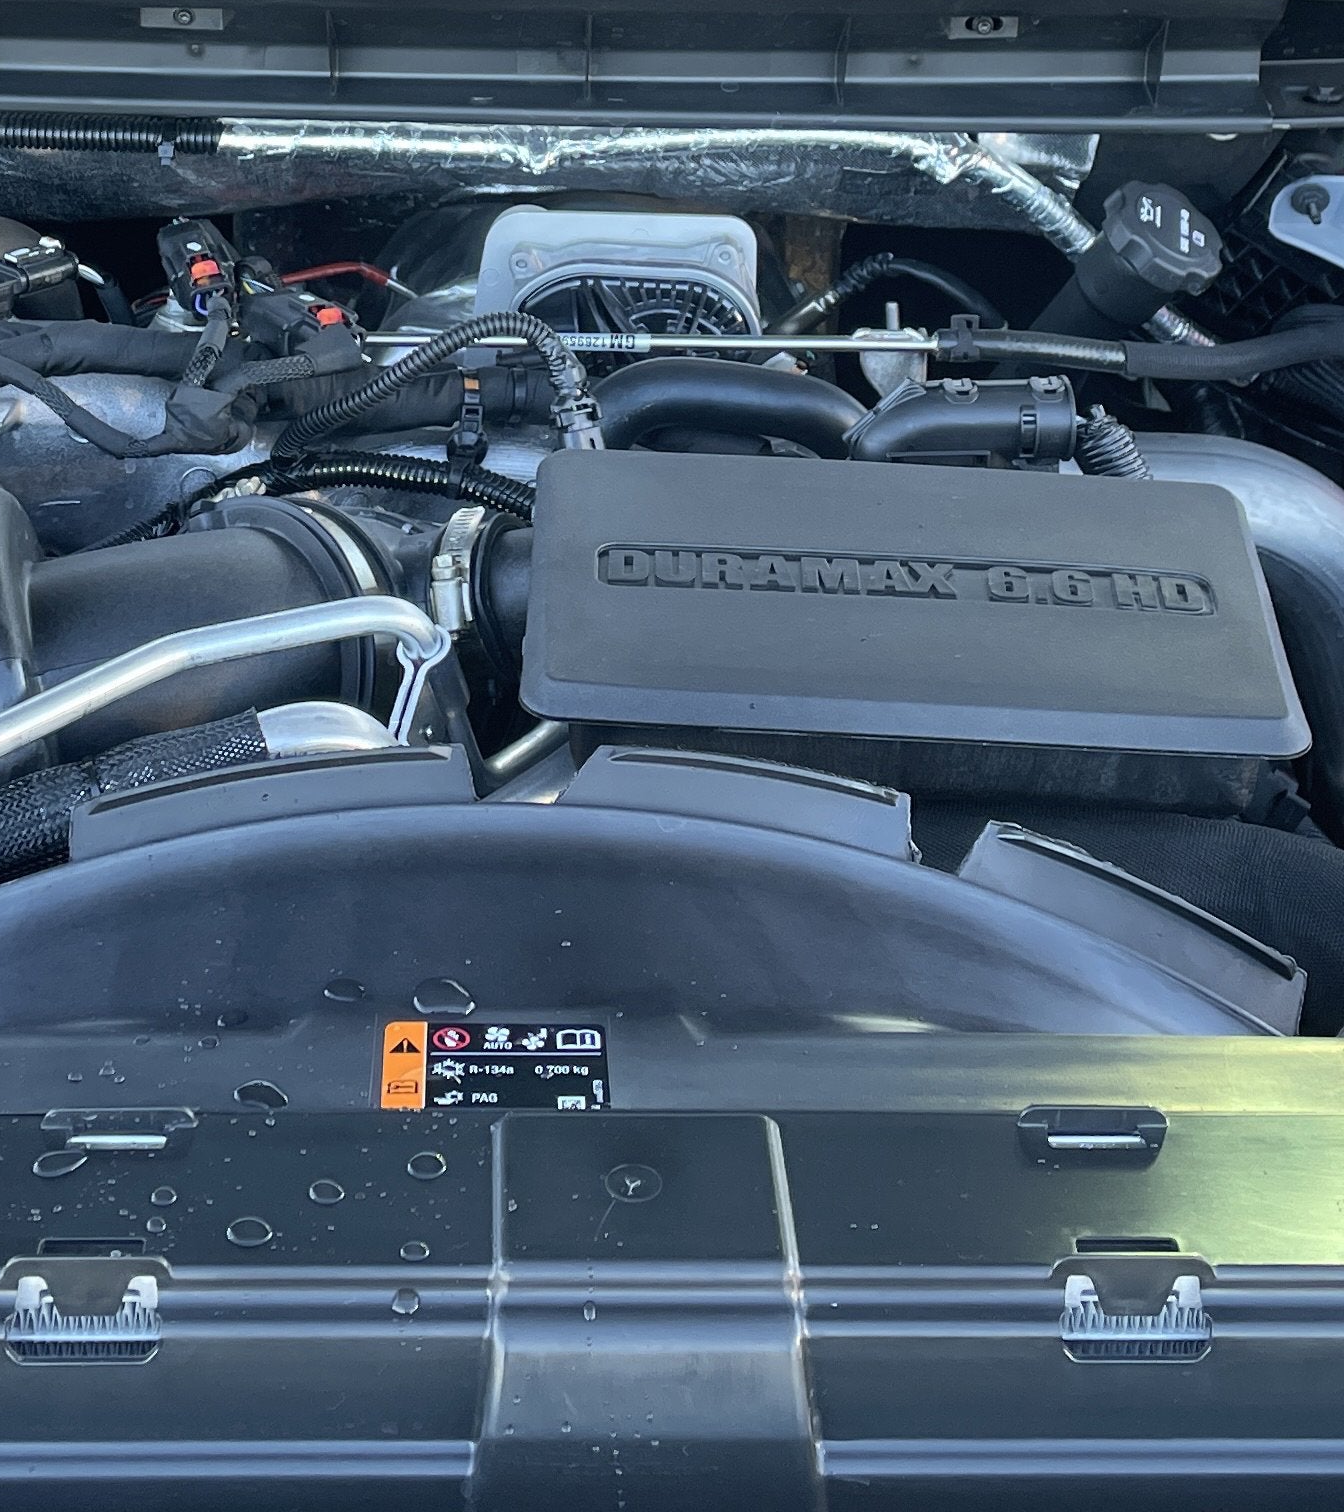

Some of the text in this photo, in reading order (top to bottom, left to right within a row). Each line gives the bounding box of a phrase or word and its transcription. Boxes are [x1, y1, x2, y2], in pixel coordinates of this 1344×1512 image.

[610, 334, 635, 350] GM
[607, 549, 1210, 613] DURAMAX 6.6 HD
[483, 1041, 513, 1050] AUTO
[469, 1064, 515, 1075] R-134a
[572, 1065, 589, 1077] kg
[471, 1092, 498, 1104] PAG
